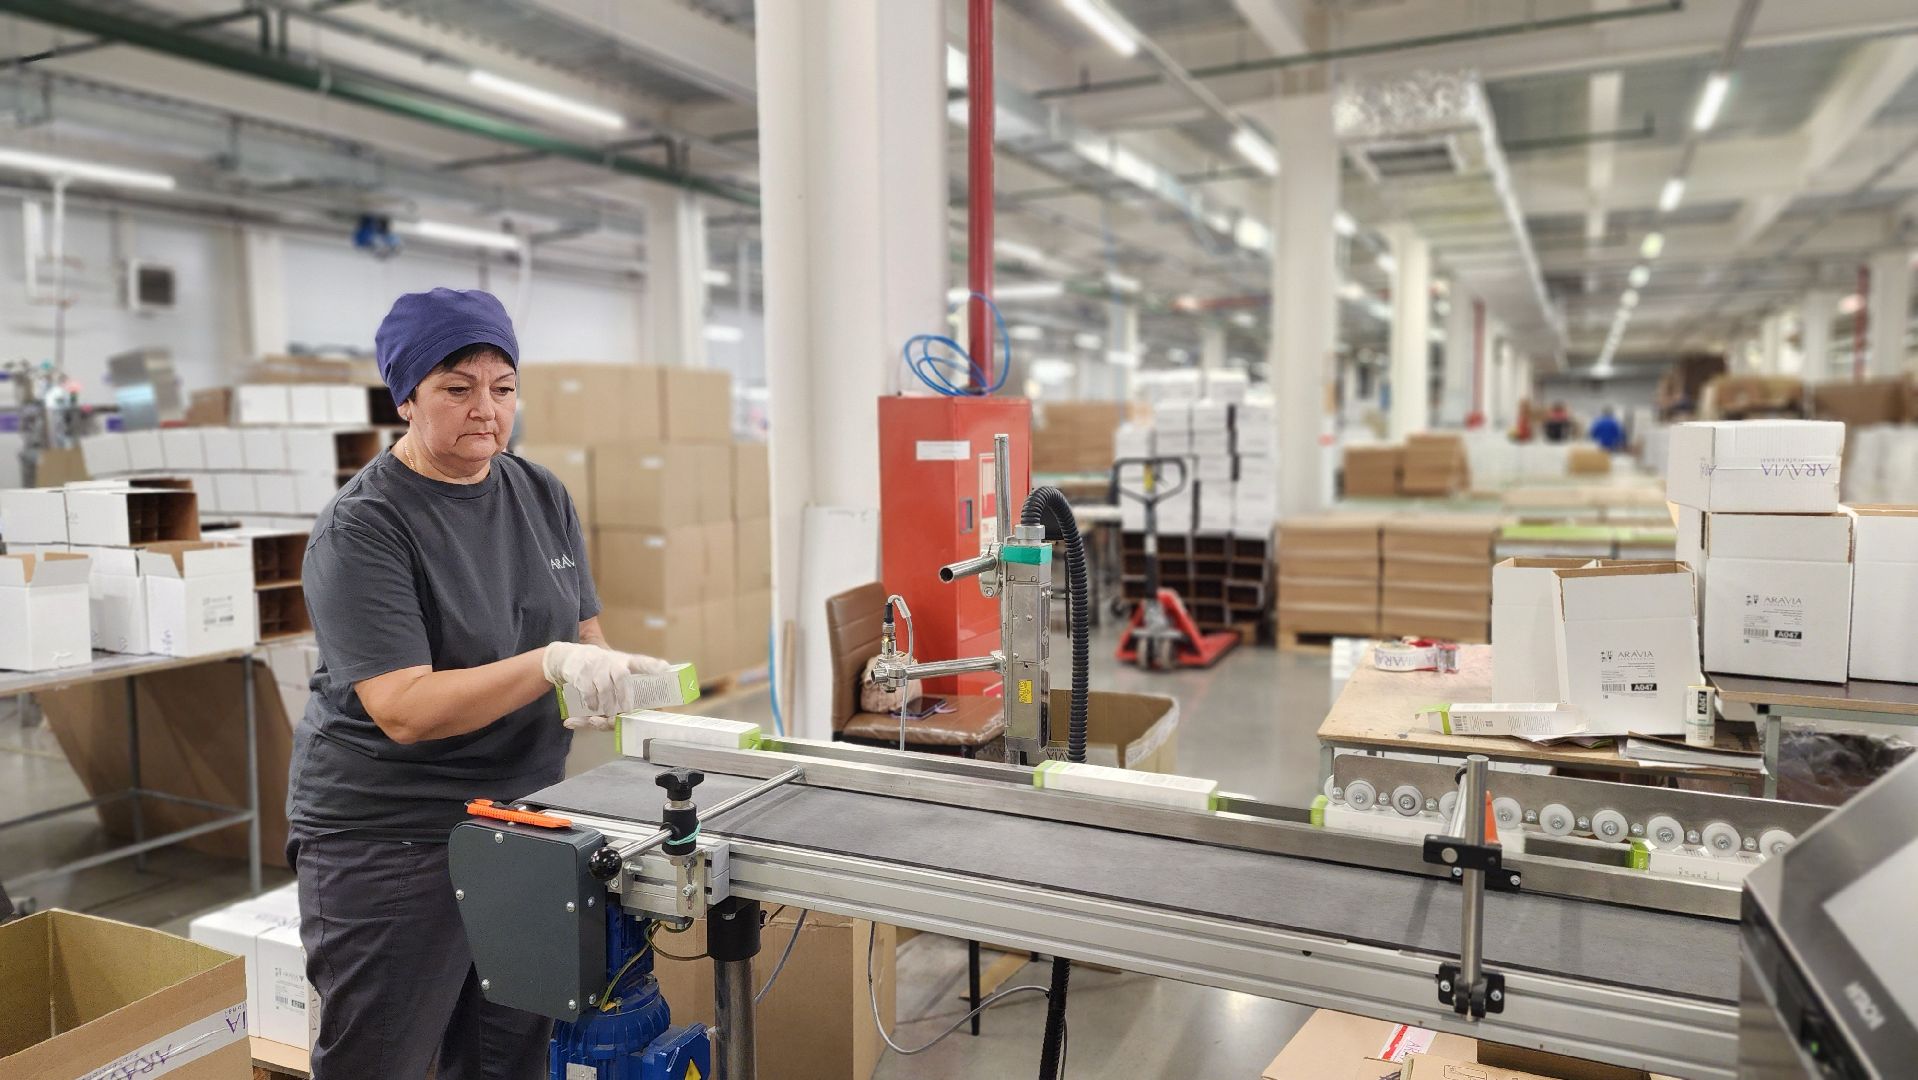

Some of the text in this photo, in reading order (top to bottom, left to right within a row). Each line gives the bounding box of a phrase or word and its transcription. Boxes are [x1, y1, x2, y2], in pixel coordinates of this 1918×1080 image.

[1761, 463, 1832, 481] ARAVIA
[1764, 595, 1802, 606] ARAVIA
[1777, 630, 1800, 639] A047
[1618, 650, 1654, 658] ARAVIA
[1633, 683, 1655, 691] A047
[1698, 692, 1707, 712] A047
